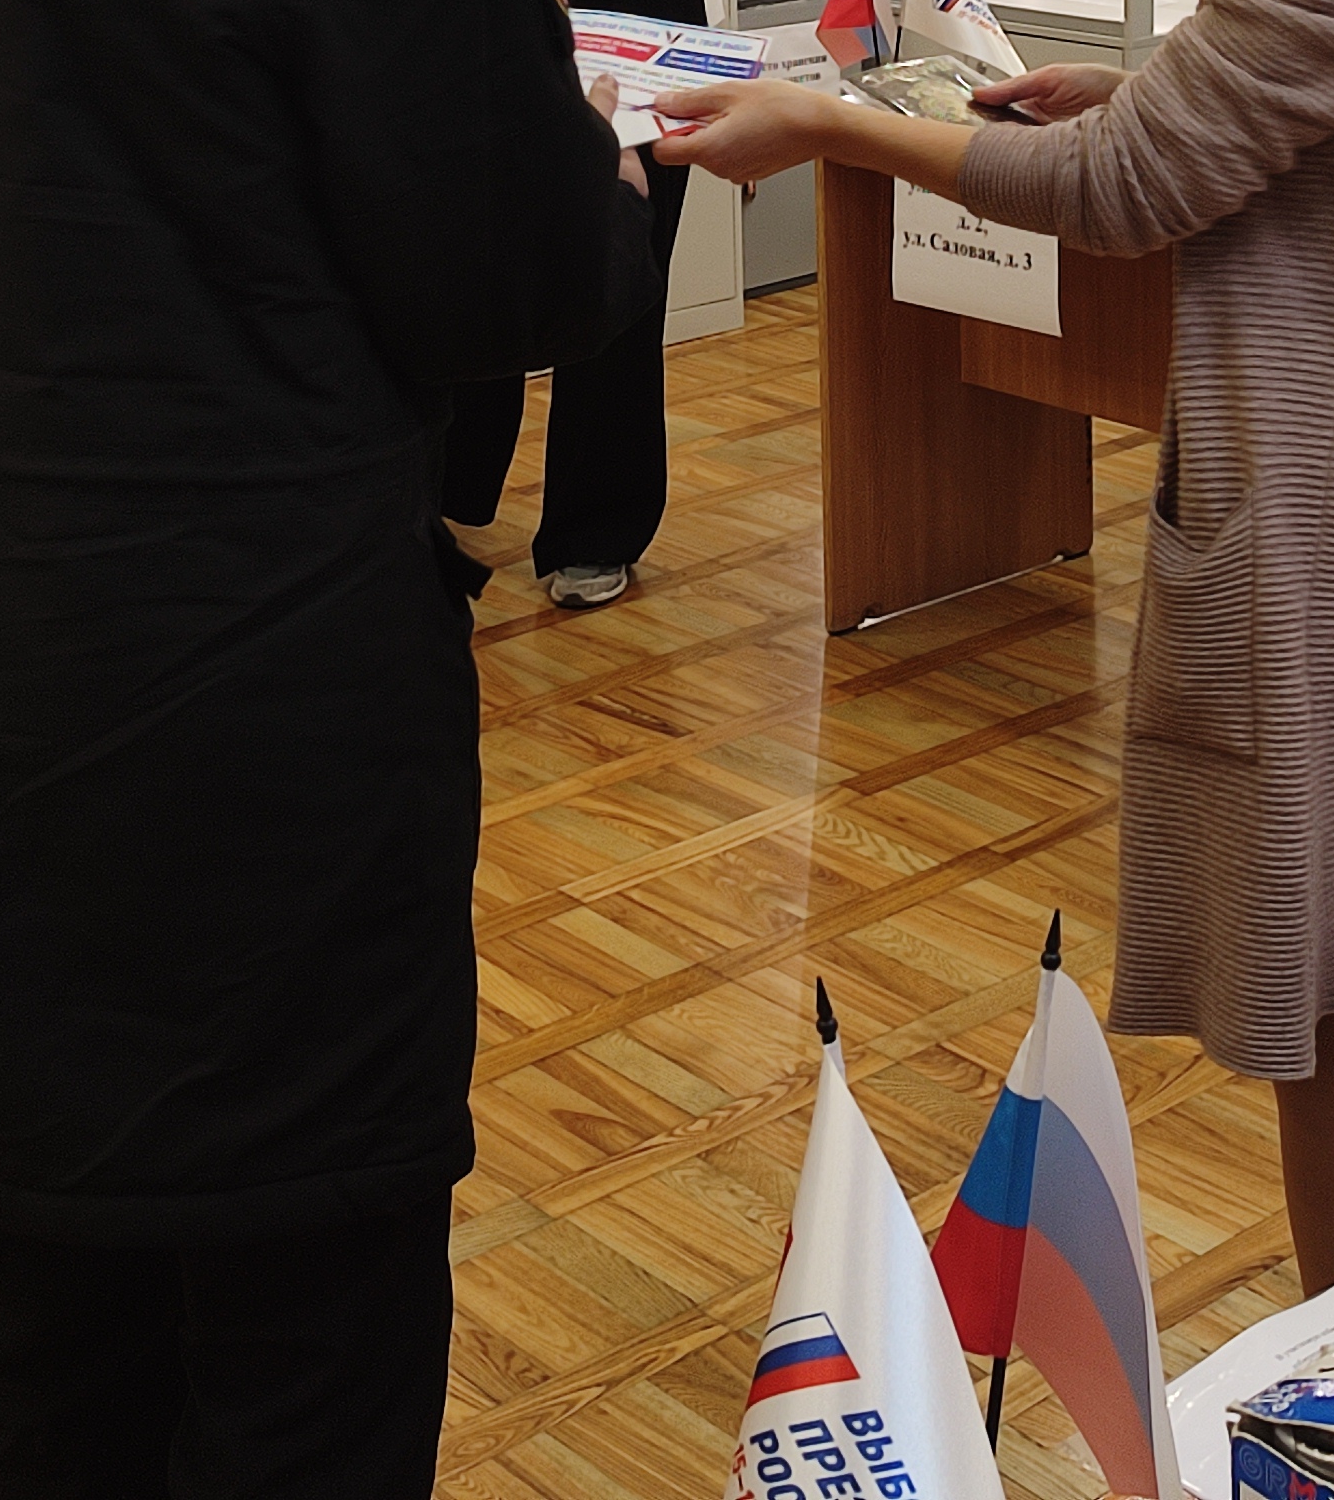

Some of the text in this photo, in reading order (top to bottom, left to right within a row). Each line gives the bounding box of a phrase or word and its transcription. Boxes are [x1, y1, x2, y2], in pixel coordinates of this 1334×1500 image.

[903, 231, 1032, 271] ул. Садовая, д. 3
[788, 1419, 867, 1500] ПРЕ
[841, 1409, 917, 1500] ВЫБ
